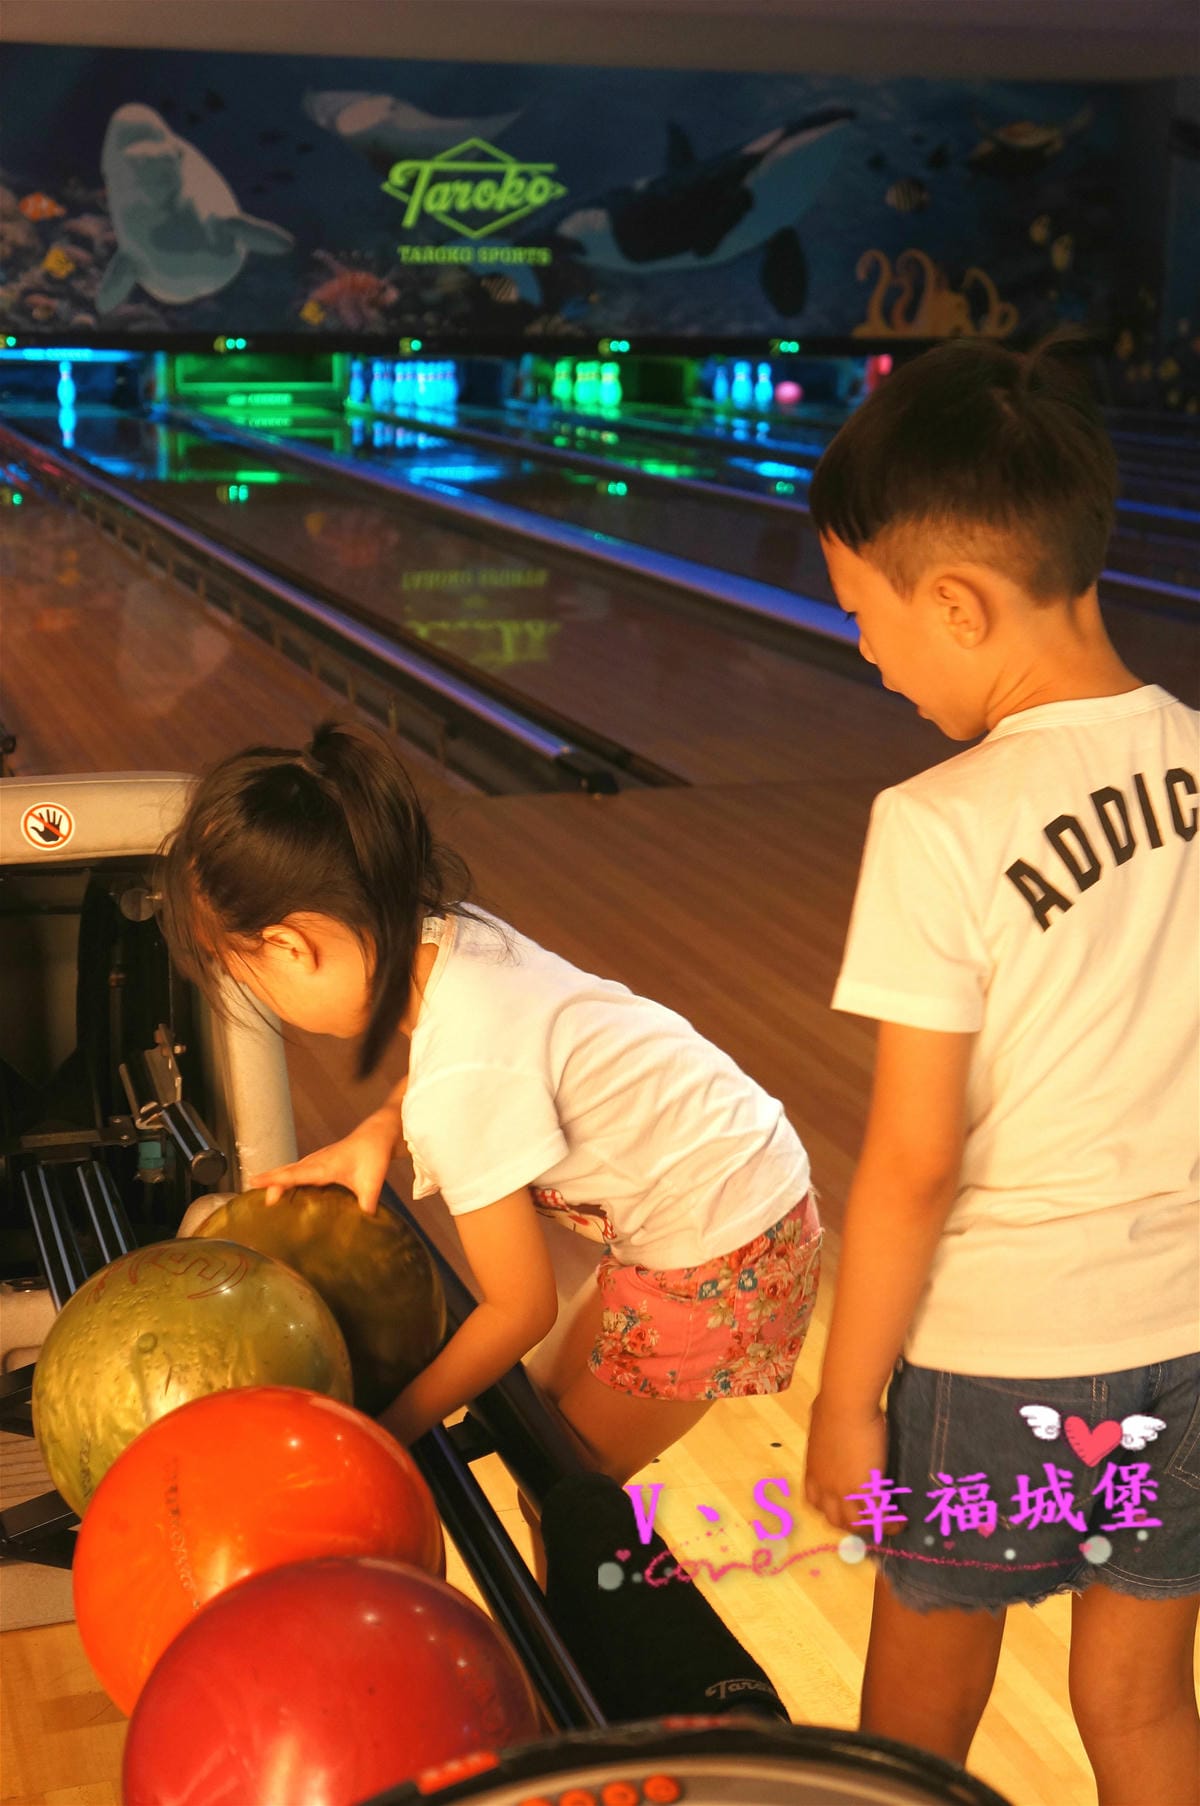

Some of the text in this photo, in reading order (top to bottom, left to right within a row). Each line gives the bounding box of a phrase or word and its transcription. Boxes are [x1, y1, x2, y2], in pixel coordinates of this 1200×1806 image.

[387, 160, 558, 229] Taroko
[398, 245, 552, 266] TAROKO SPORTS
